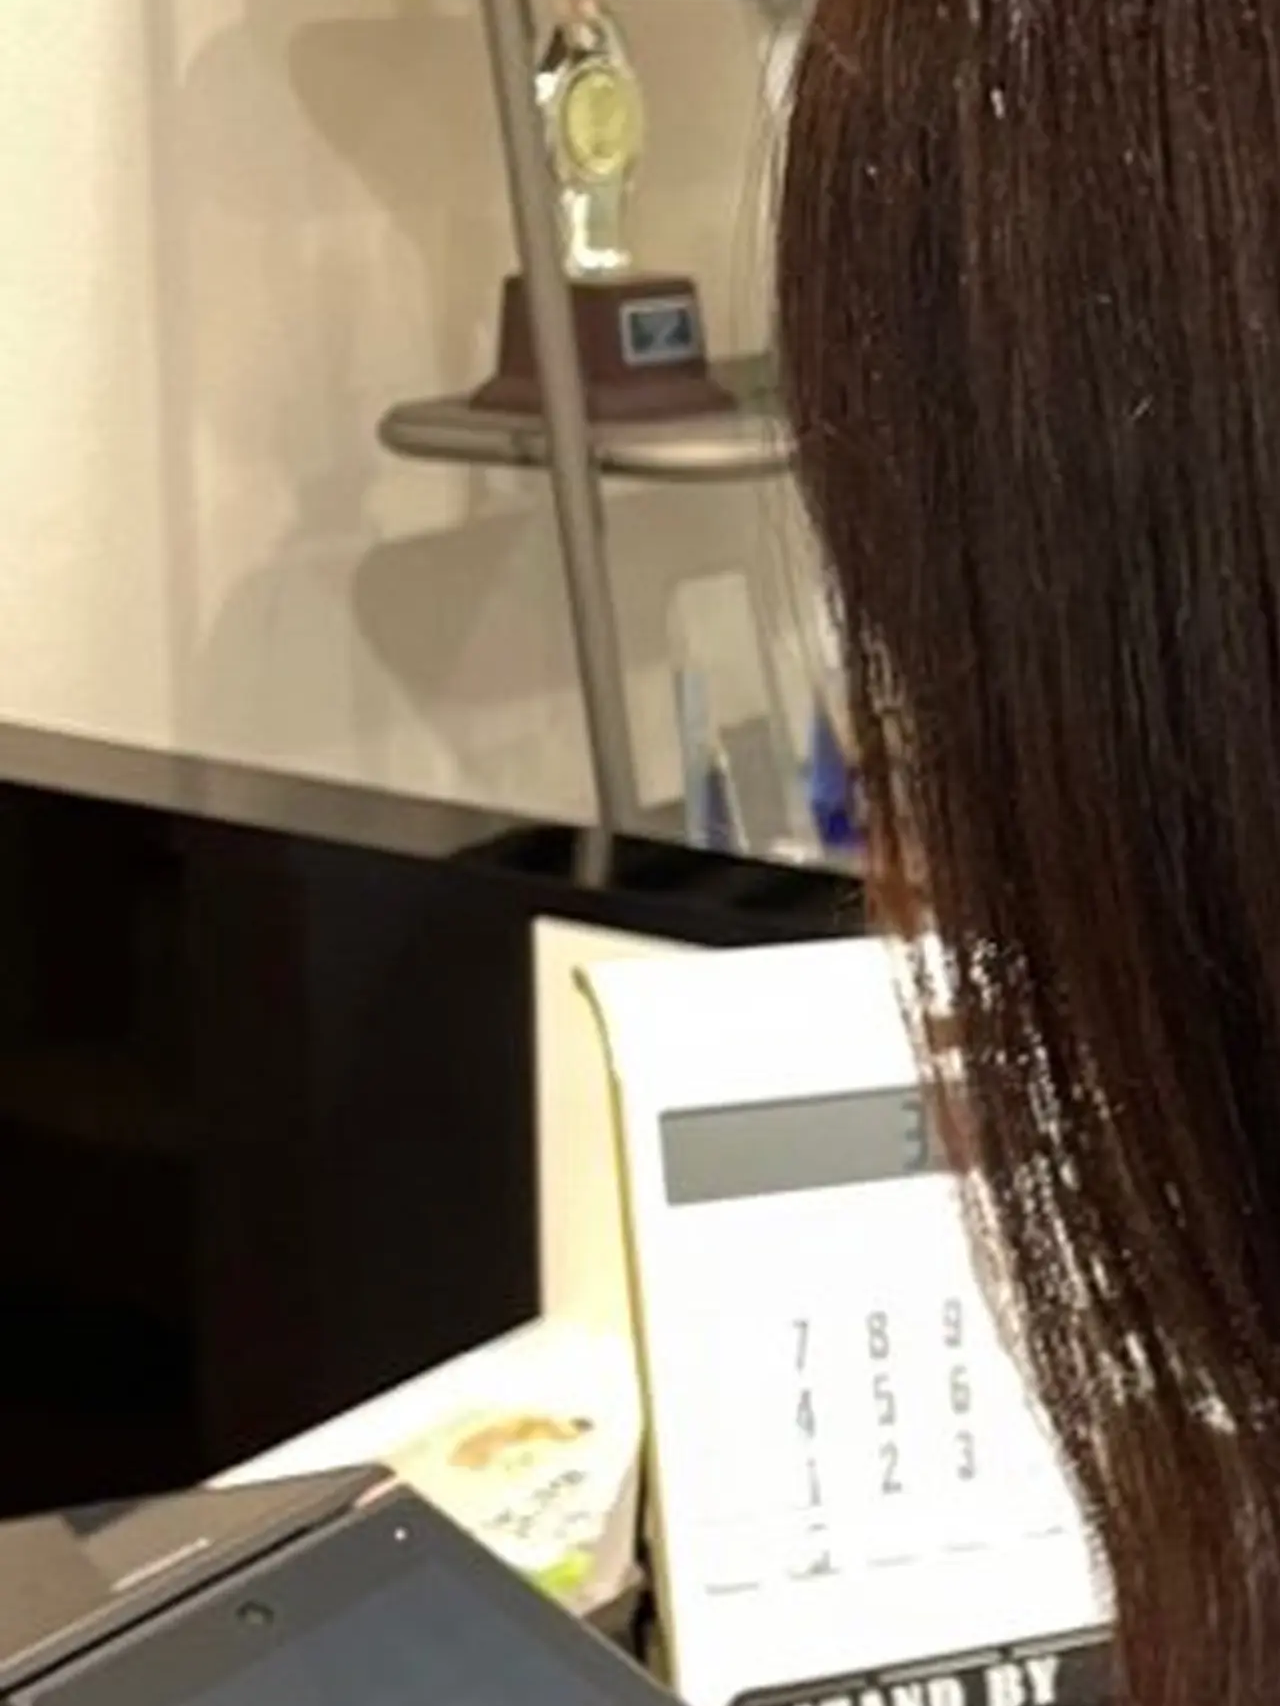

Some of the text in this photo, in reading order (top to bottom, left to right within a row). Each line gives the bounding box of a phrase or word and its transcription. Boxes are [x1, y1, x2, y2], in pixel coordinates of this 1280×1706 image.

[793, 1297, 963, 1371] 7 8 9
[796, 1363, 972, 1440] 4 5 6
[806, 1429, 977, 1507] 1 2 3
